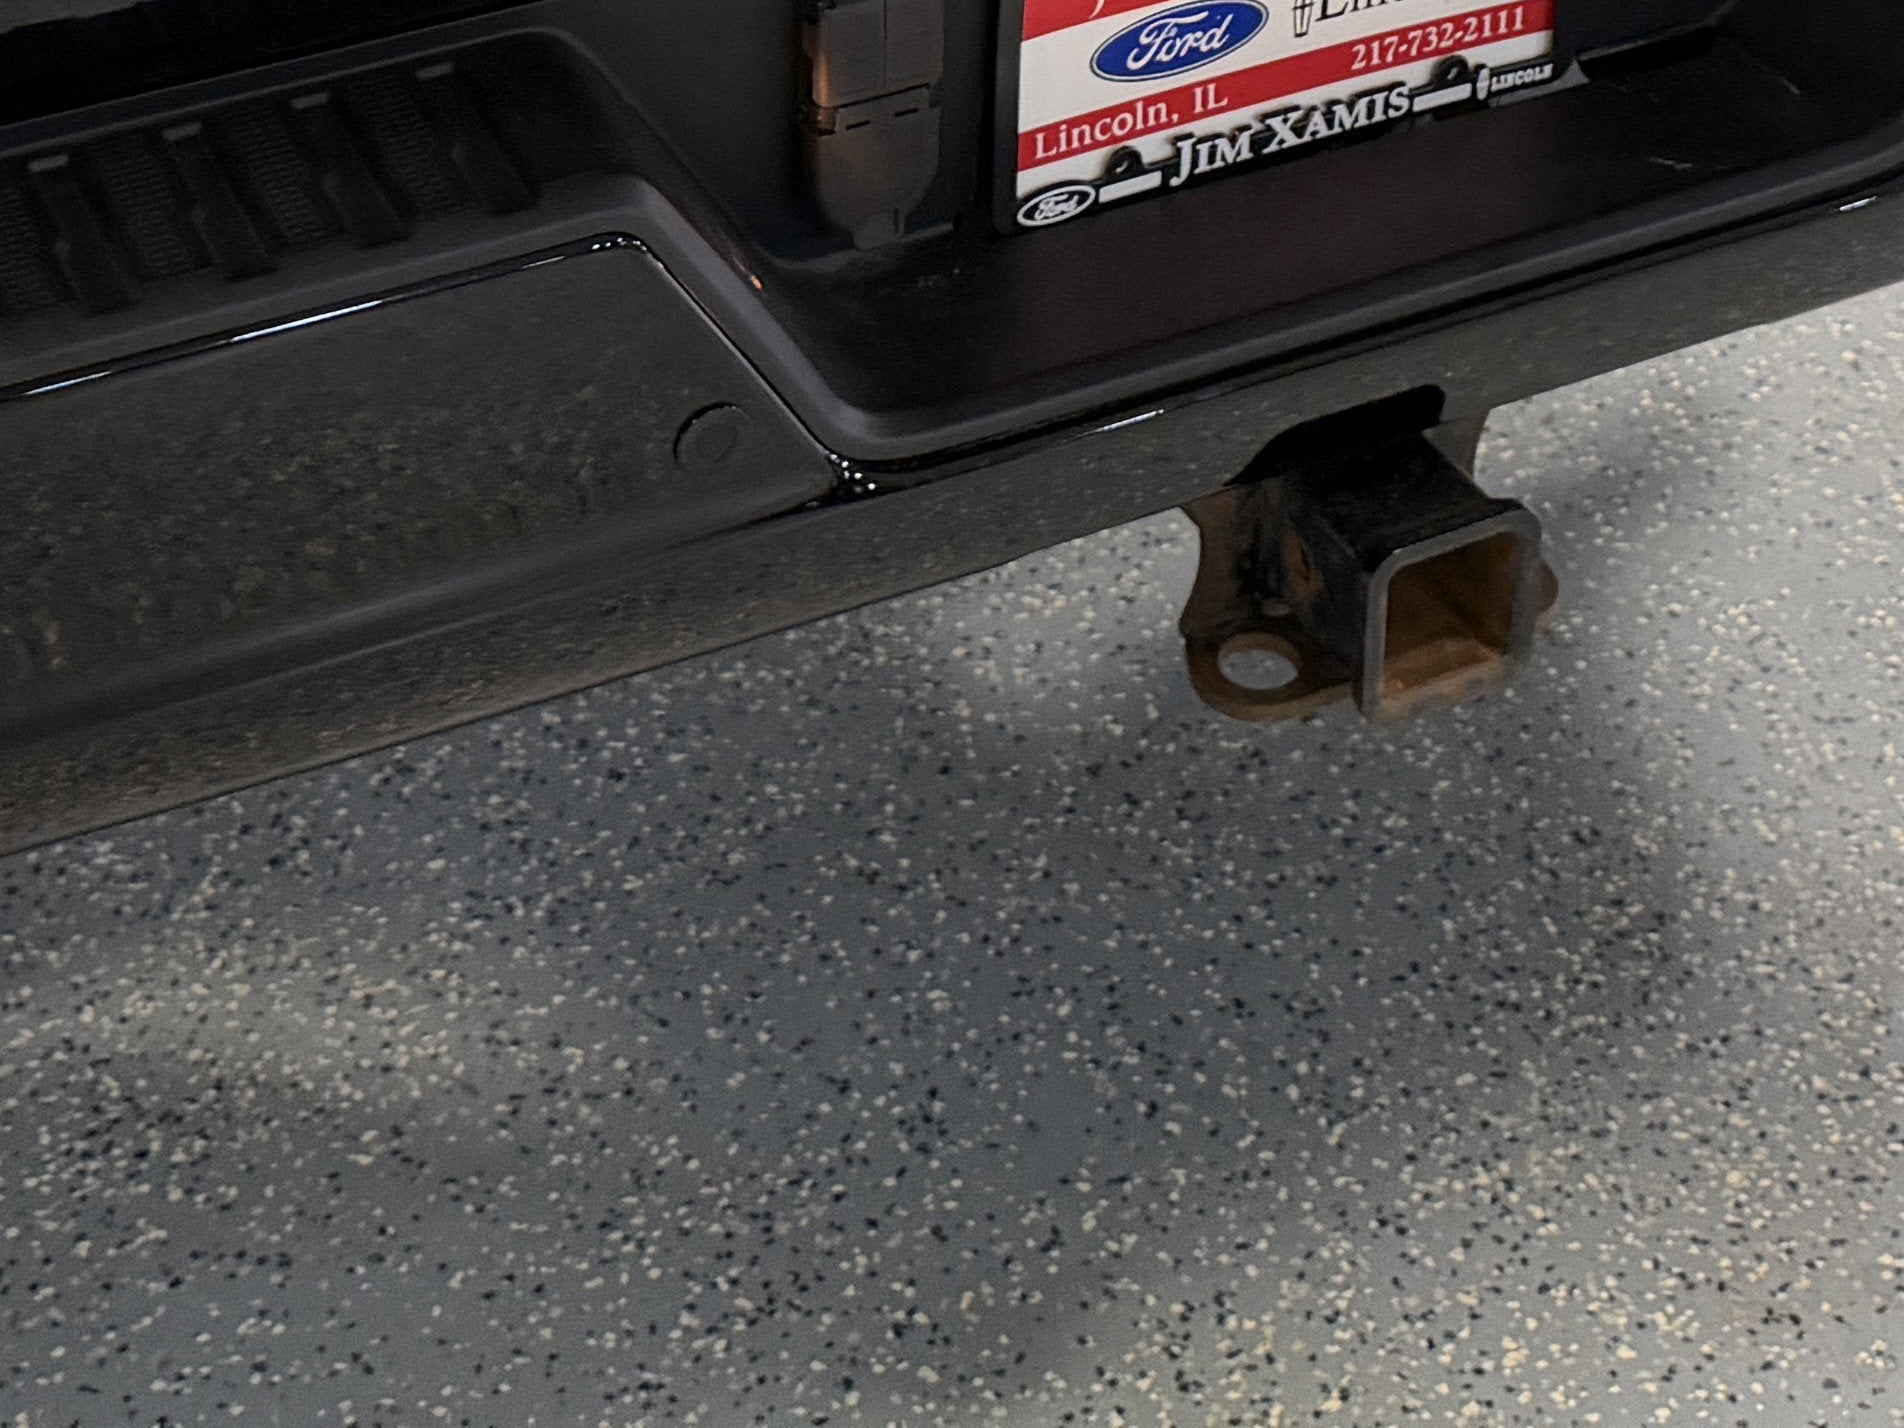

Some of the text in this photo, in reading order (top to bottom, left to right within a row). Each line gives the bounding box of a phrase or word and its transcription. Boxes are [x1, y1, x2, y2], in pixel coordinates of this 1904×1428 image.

[1126, 8, 1236, 72] Ford
[1350, 4, 1526, 71] 217-732-2111
[1034, 82, 1229, 159] Lincoln, IL
[1169, 84, 1412, 187] JIM XAMIS
[1033, 193, 1080, 222] Ford
